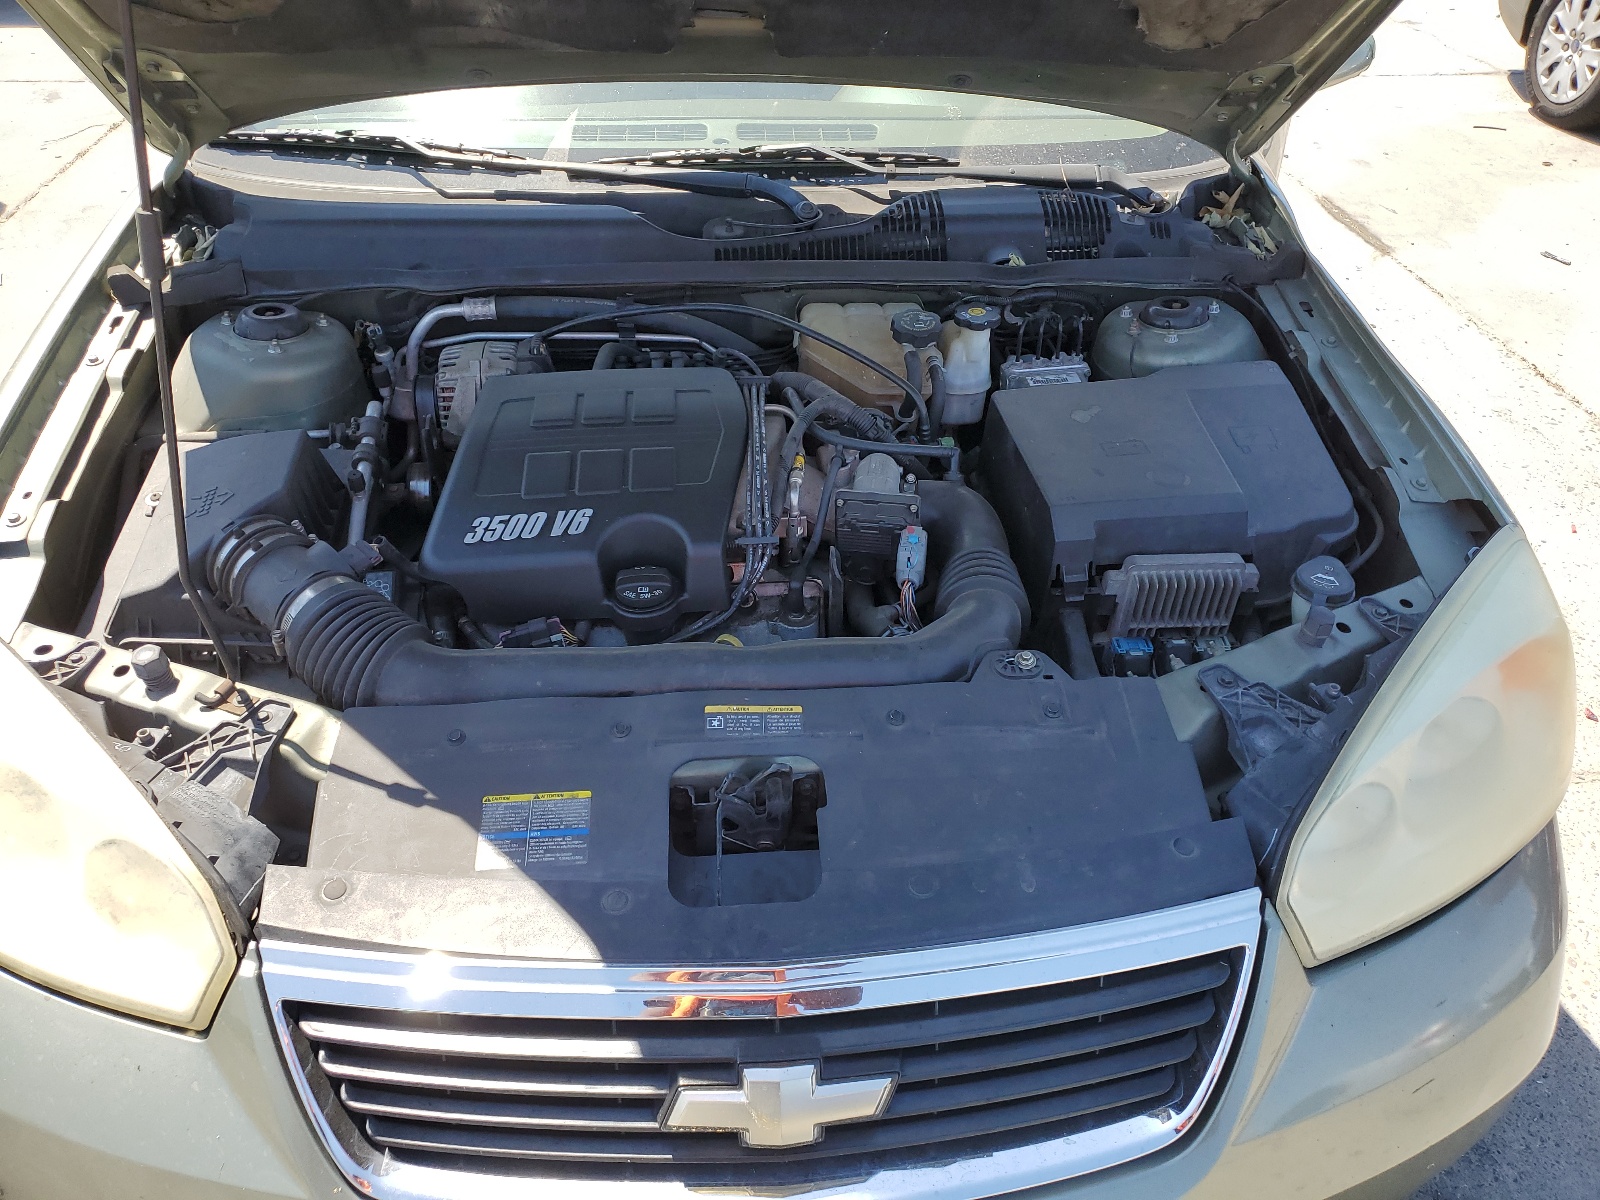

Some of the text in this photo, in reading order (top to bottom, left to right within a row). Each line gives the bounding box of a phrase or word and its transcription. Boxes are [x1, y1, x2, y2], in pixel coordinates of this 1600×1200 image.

[463, 508, 594, 544] 3500 V6
[623, 590, 636, 599] SAE
